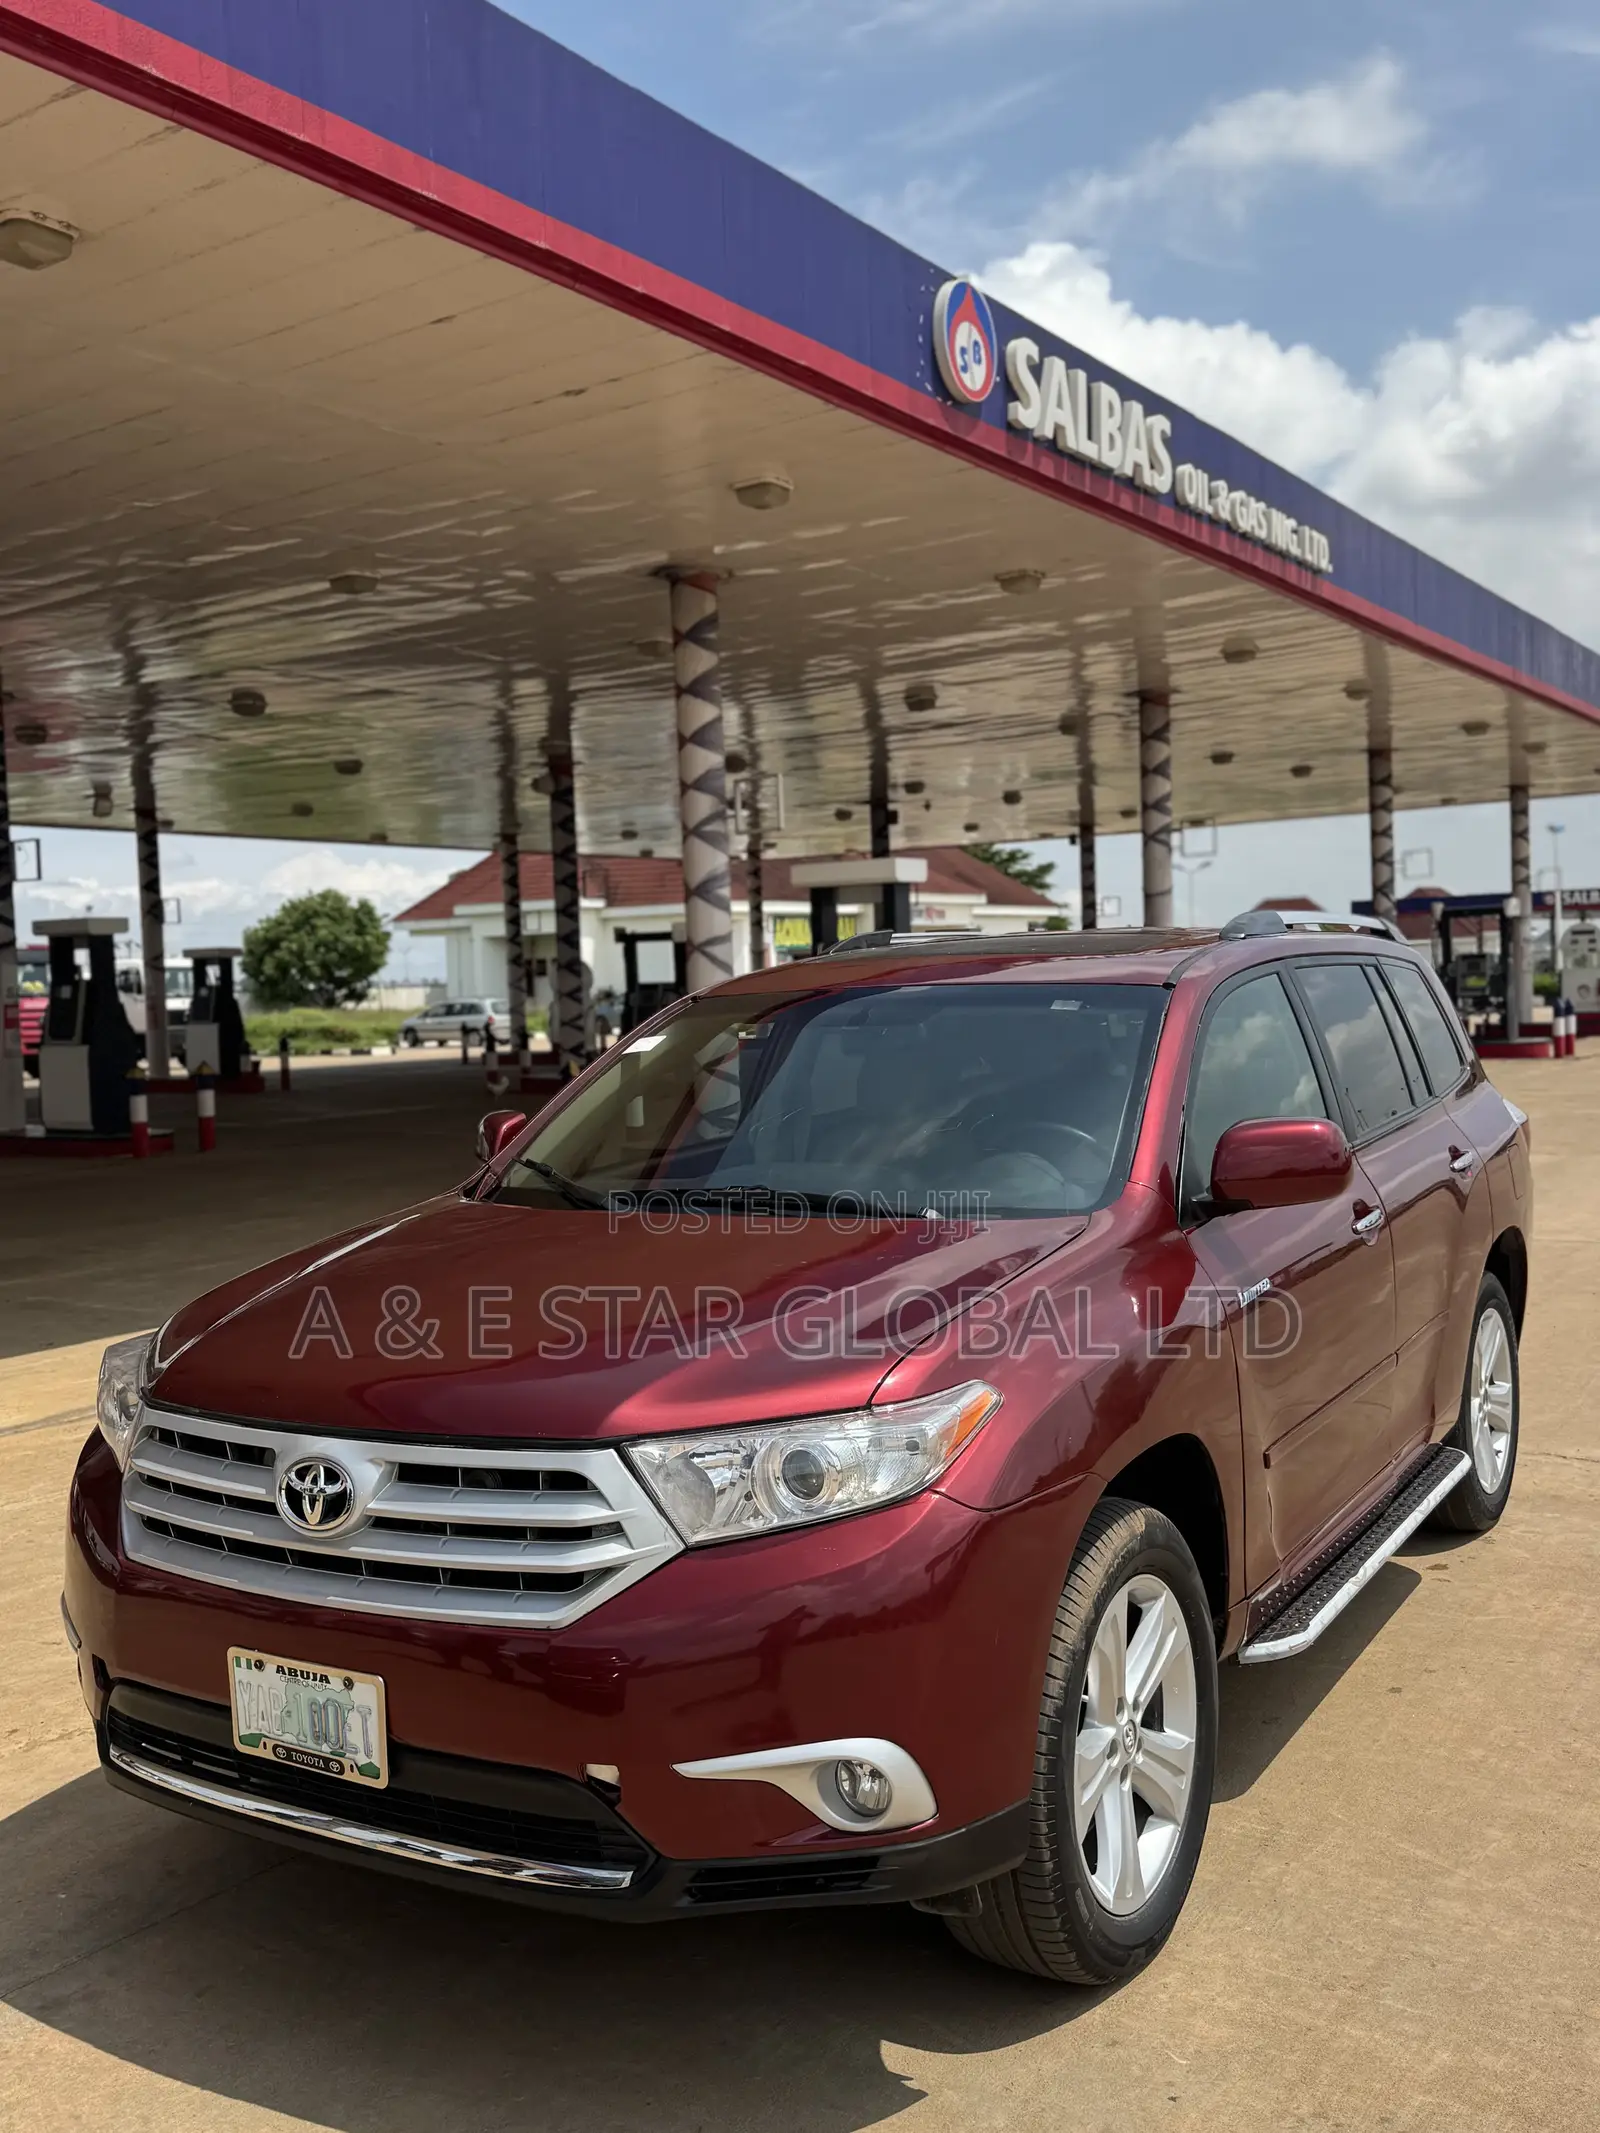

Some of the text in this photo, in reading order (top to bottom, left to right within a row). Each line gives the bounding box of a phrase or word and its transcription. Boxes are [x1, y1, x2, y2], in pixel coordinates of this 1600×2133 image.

[1006, 337, 1173, 494] SALBAS
[1175, 463, 1213, 514] OIL
[1228, 490, 1268, 540] GAS
[275, 1664, 331, 1685] ABUJA
[290, 1751, 325, 1768] TOYOTA
